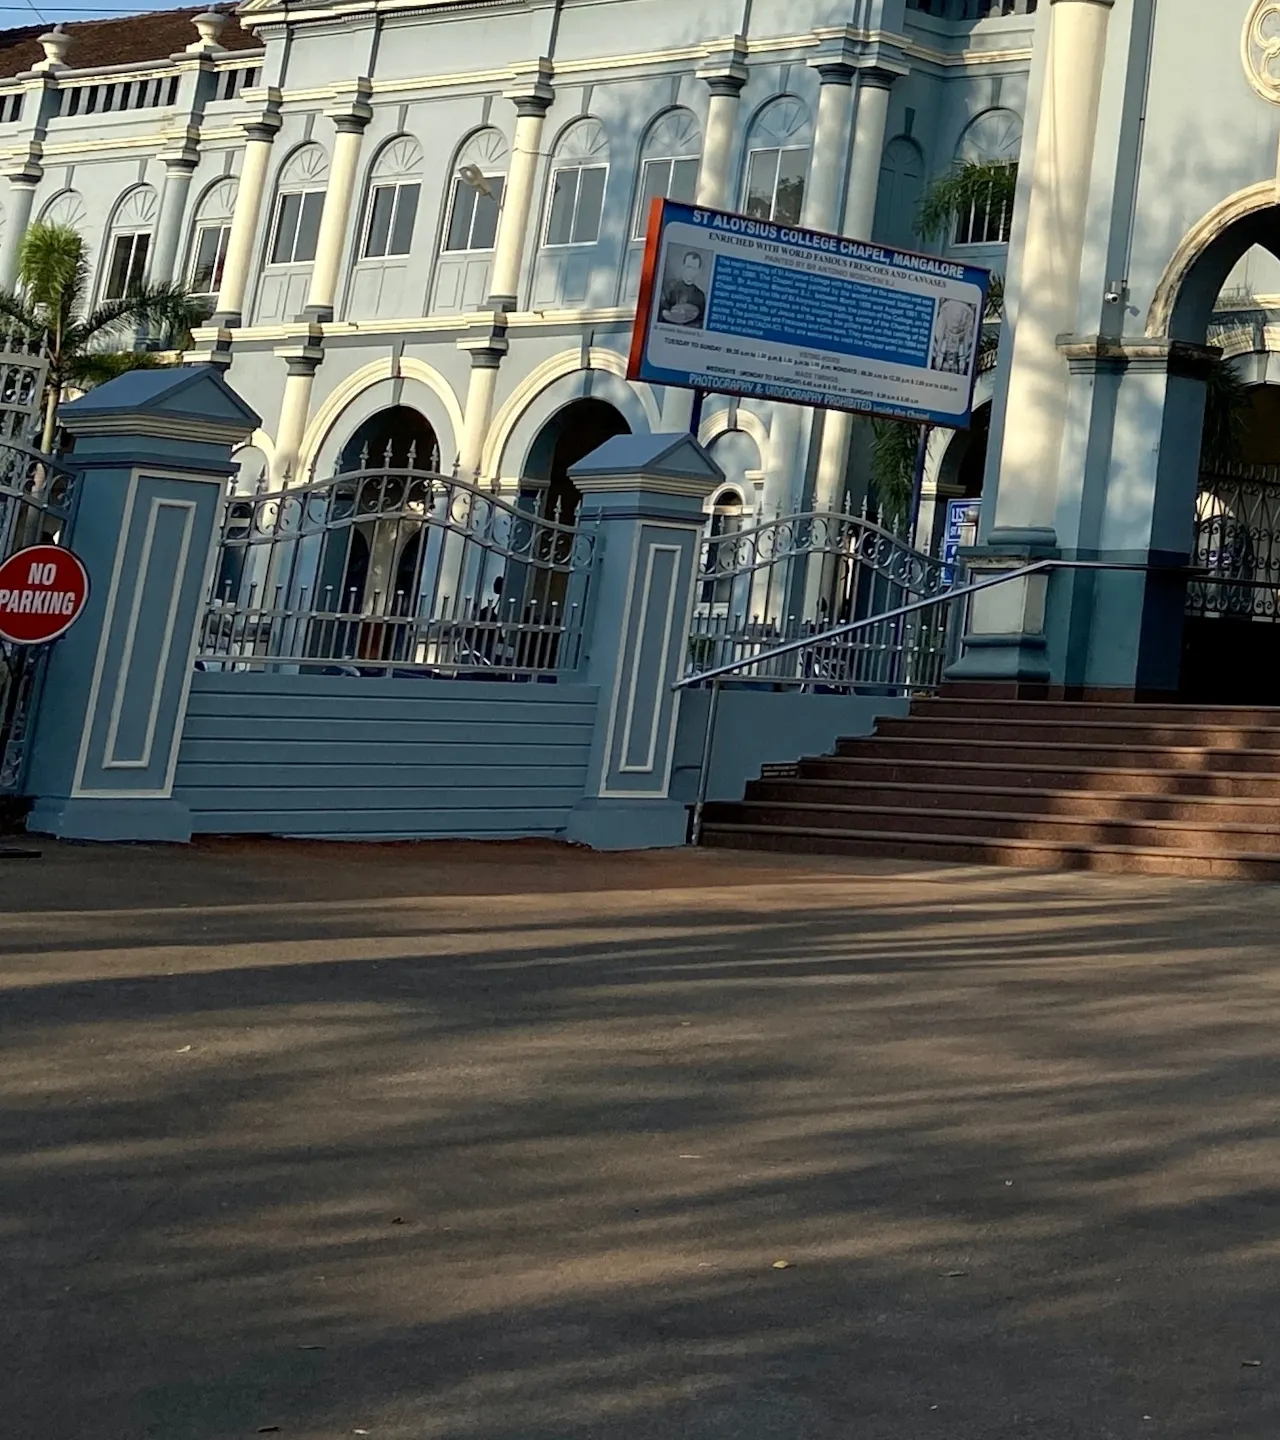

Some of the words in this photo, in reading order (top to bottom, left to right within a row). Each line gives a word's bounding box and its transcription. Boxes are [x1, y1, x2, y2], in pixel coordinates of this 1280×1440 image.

[693, 210, 711, 225] ST
[713, 214, 778, 239] ALOYSIUS
[780, 229, 837, 251] COLLEGE
[839, 242, 891, 264] CHAPEL,
[893, 253, 964, 278] MANGALORE
[709, 232, 755, 248] ENRICHED
[756, 242, 779, 253] WITH
[781, 247, 812, 260] WORLD
[814, 254, 848, 267] FAMOUS
[849, 261, 890, 276] FRESCOES
[891, 270, 907, 280] AND
[908, 273, 947, 288] CANVASES
[795, 261, 806, 269] BY
[689, 374, 755, 393] PHOTOGRAPHY
[756, 384, 764, 395] &
[824, 394, 873, 411] PROHIBITED
[27, 562, 57, 585] NO
[0, 589, 76, 615] PARKING
